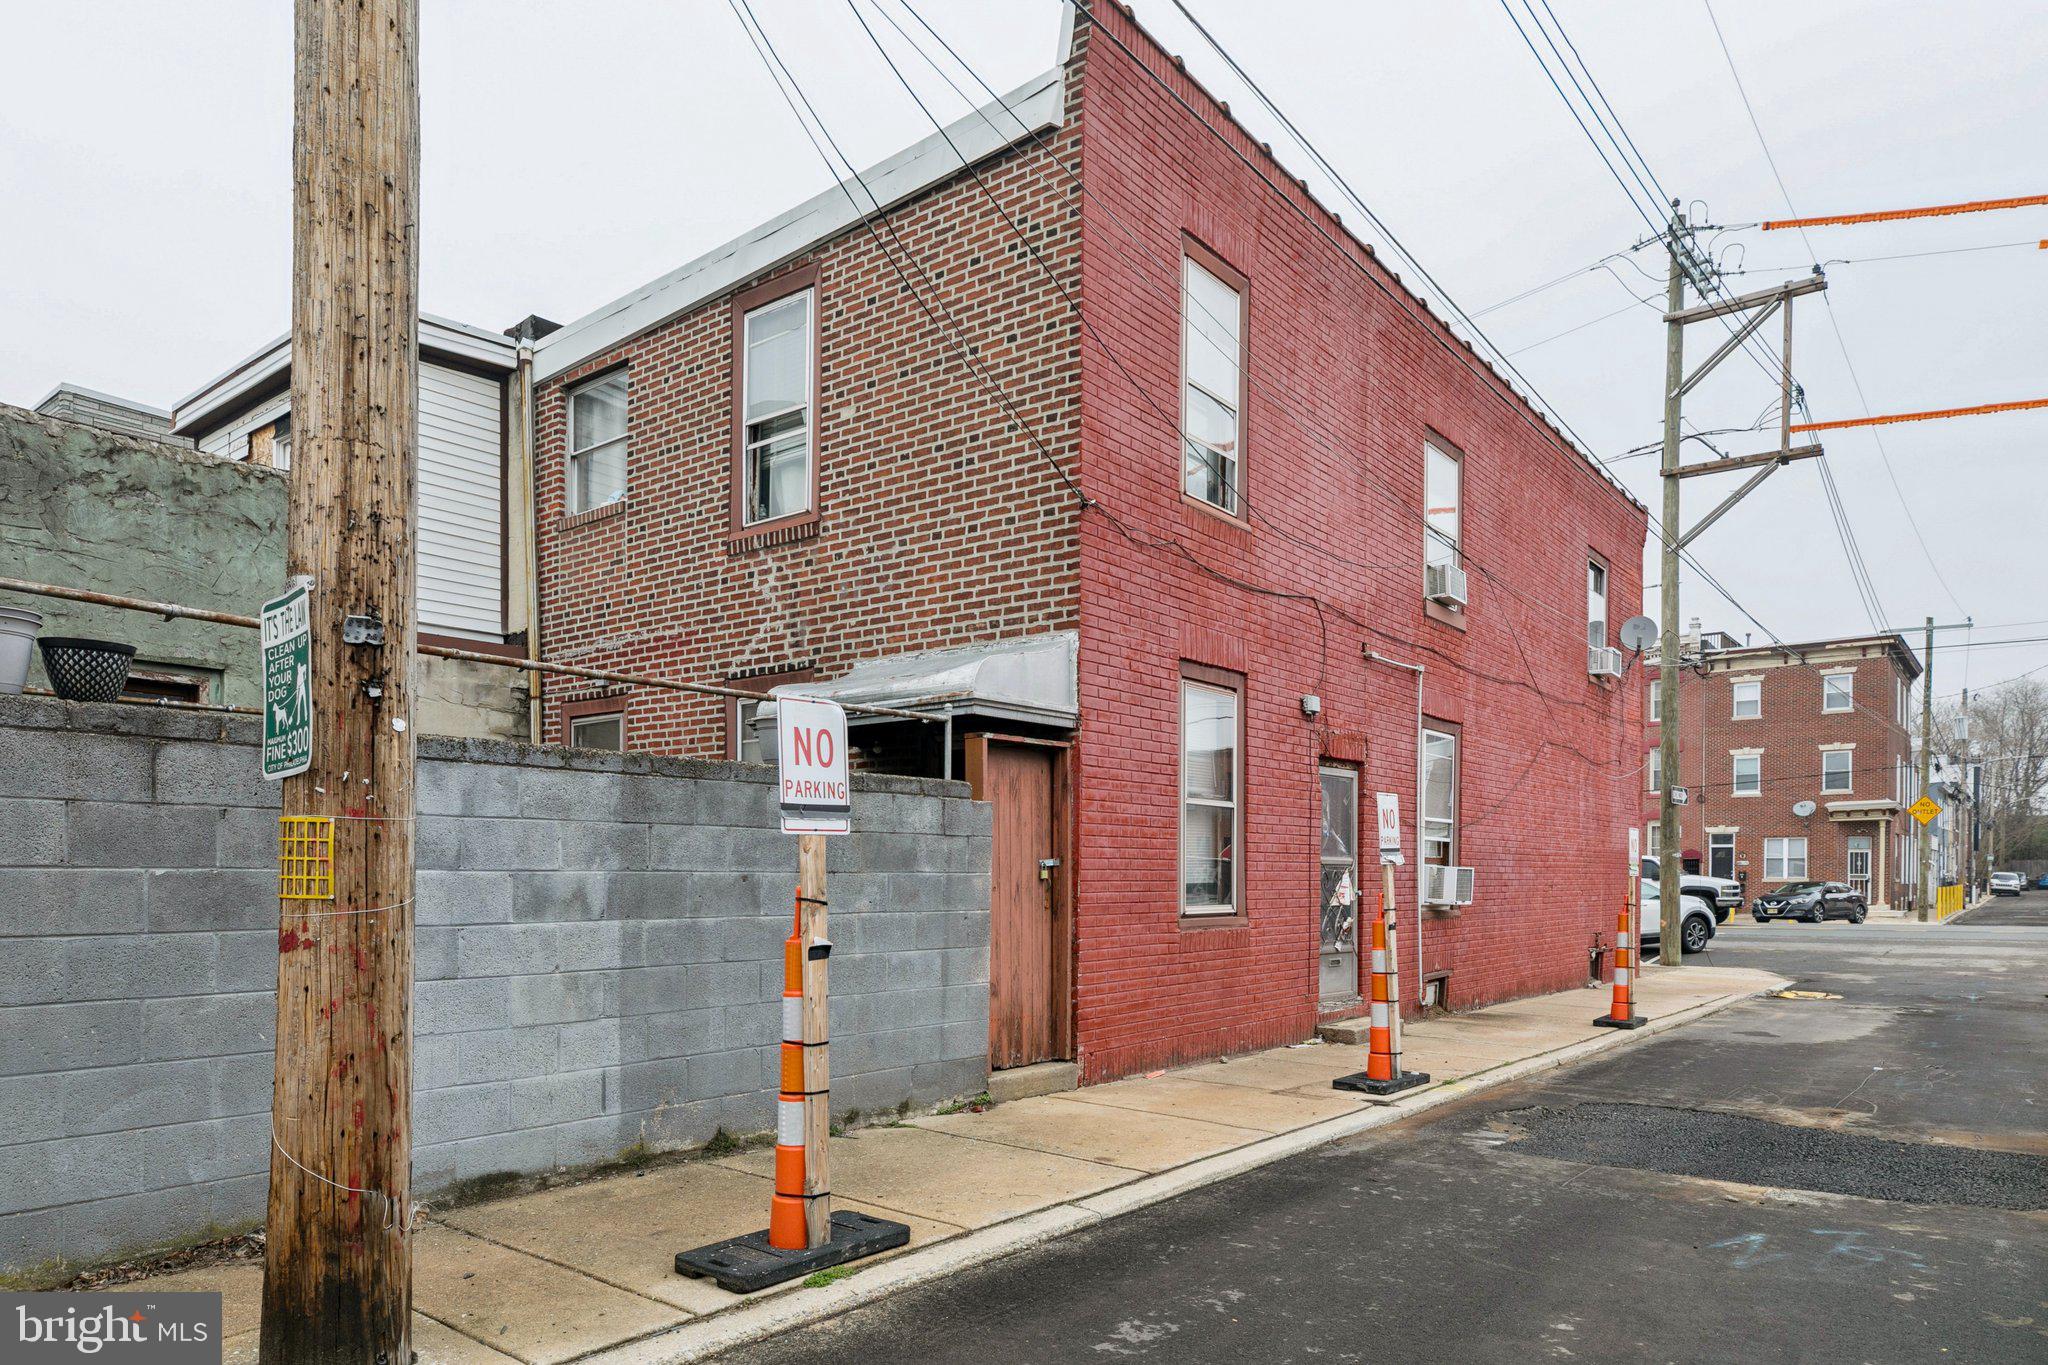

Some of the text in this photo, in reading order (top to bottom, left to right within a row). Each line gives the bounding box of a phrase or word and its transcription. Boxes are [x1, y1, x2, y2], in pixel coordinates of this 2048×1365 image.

[281, 606, 294, 637] THE
[268, 634, 307, 660] CLEAN UP
[269, 655, 295, 675] AFTER
[269, 670, 292, 688] YOUR
[268, 686, 287, 702] DOG
[266, 726, 309, 762] FINE $300
[793, 726, 834, 769] NO
[785, 779, 845, 800] PARKING
[1382, 808, 1395, 830] NO
